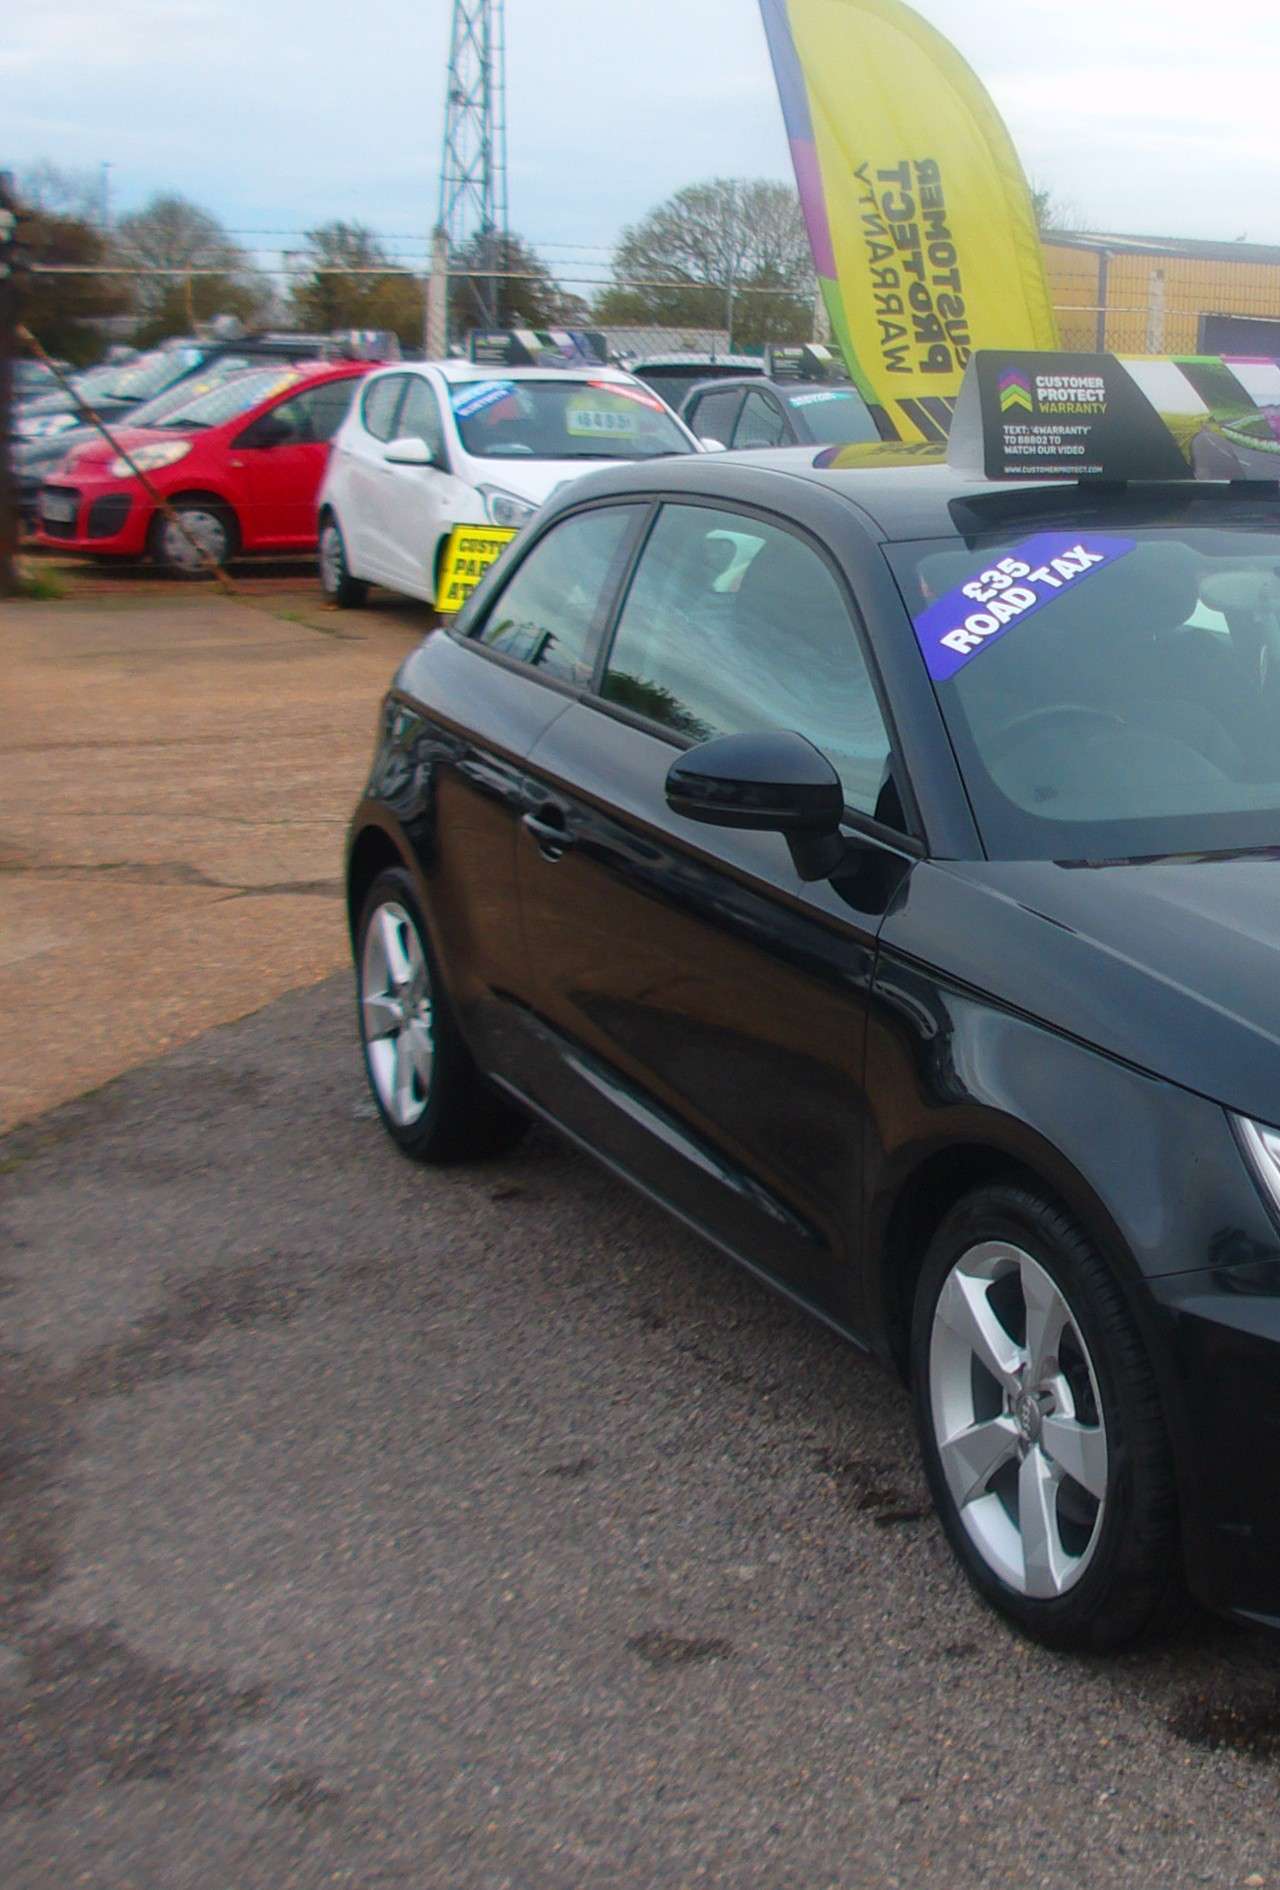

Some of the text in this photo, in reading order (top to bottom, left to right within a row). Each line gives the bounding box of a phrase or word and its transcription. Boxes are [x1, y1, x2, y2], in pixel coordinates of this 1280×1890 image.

[1035, 375, 1104, 388] CUSTOMER
[1037, 388, 1106, 402] PROTECT
[1039, 402, 1108, 414] WARRANTY
[1003, 435, 1016, 445] TO
[1049, 436, 1061, 445] TO
[1003, 446, 1085, 455] WATCH OUR VIDEO
[962, 558, 1031, 603] £35
[940, 545, 1104, 655] ROAD TAX
